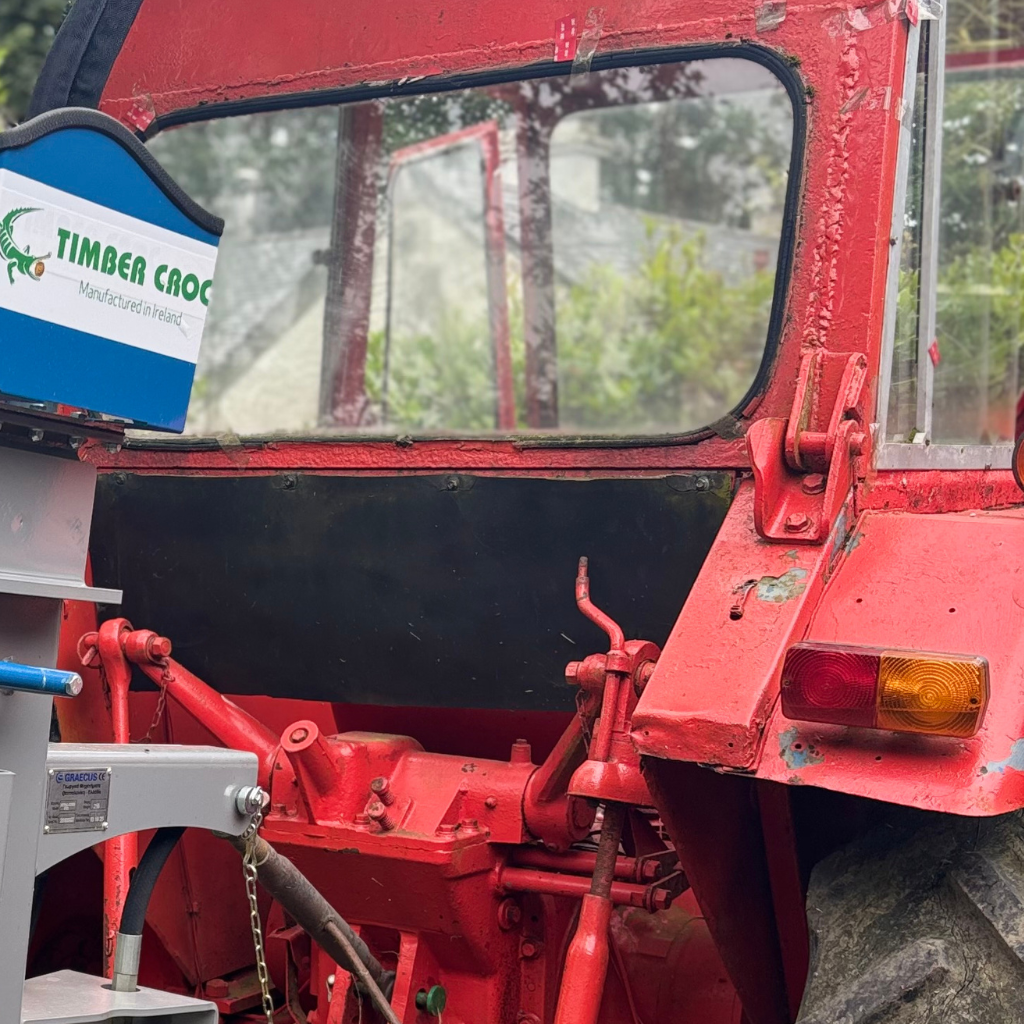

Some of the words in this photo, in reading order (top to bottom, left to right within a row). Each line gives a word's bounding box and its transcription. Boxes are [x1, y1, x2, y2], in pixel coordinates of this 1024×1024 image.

[57, 227, 148, 287] TIMBER
[154, 264, 213, 307] CROC
[78, 279, 143, 315] Manufactured
[142, 301, 151, 317] in
[152, 303, 183, 327] Ireland
[64, 773, 97, 782] GRAECUS
